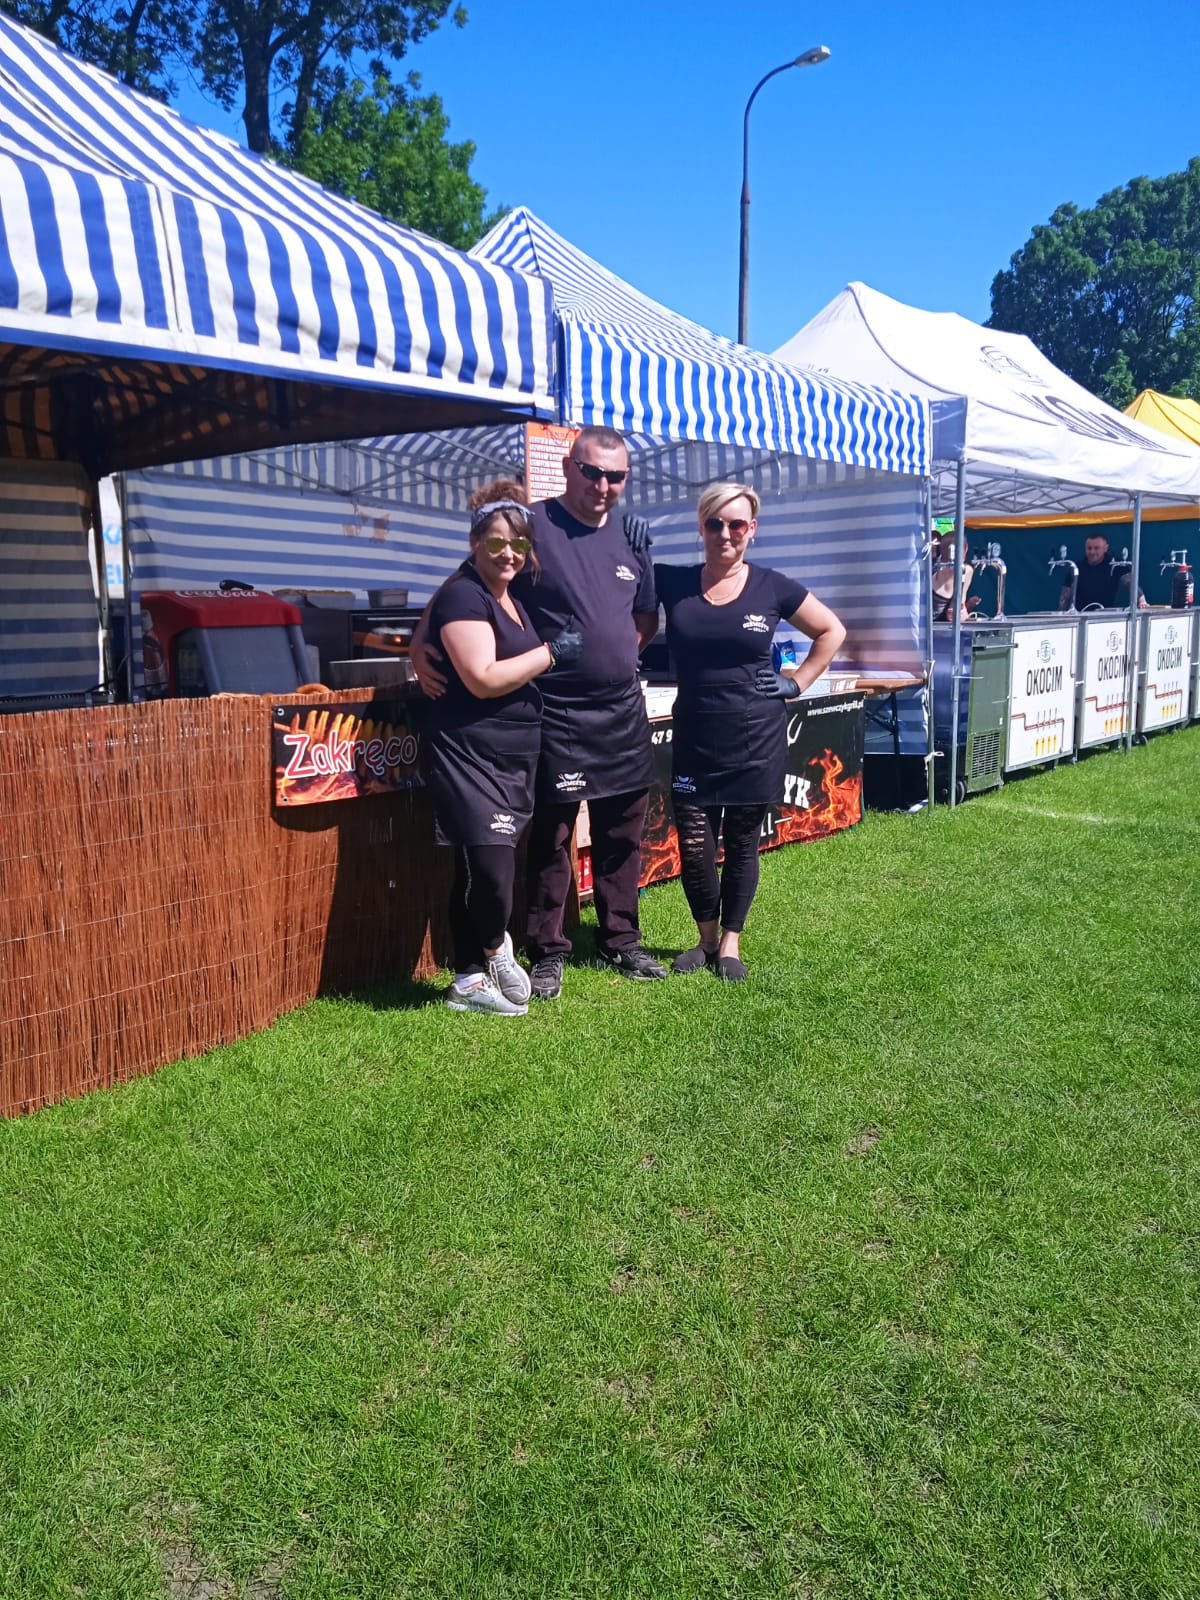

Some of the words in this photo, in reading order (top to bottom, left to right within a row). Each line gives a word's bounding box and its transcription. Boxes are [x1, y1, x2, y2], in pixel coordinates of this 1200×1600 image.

[1098, 654, 1128, 681] OKOCIM
[1157, 646, 1182, 671] OKOCIM
[1026, 665, 1062, 696] OKOCIM
[284, 730, 420, 778] Zakręco
[783, 774, 811, 809] YK
